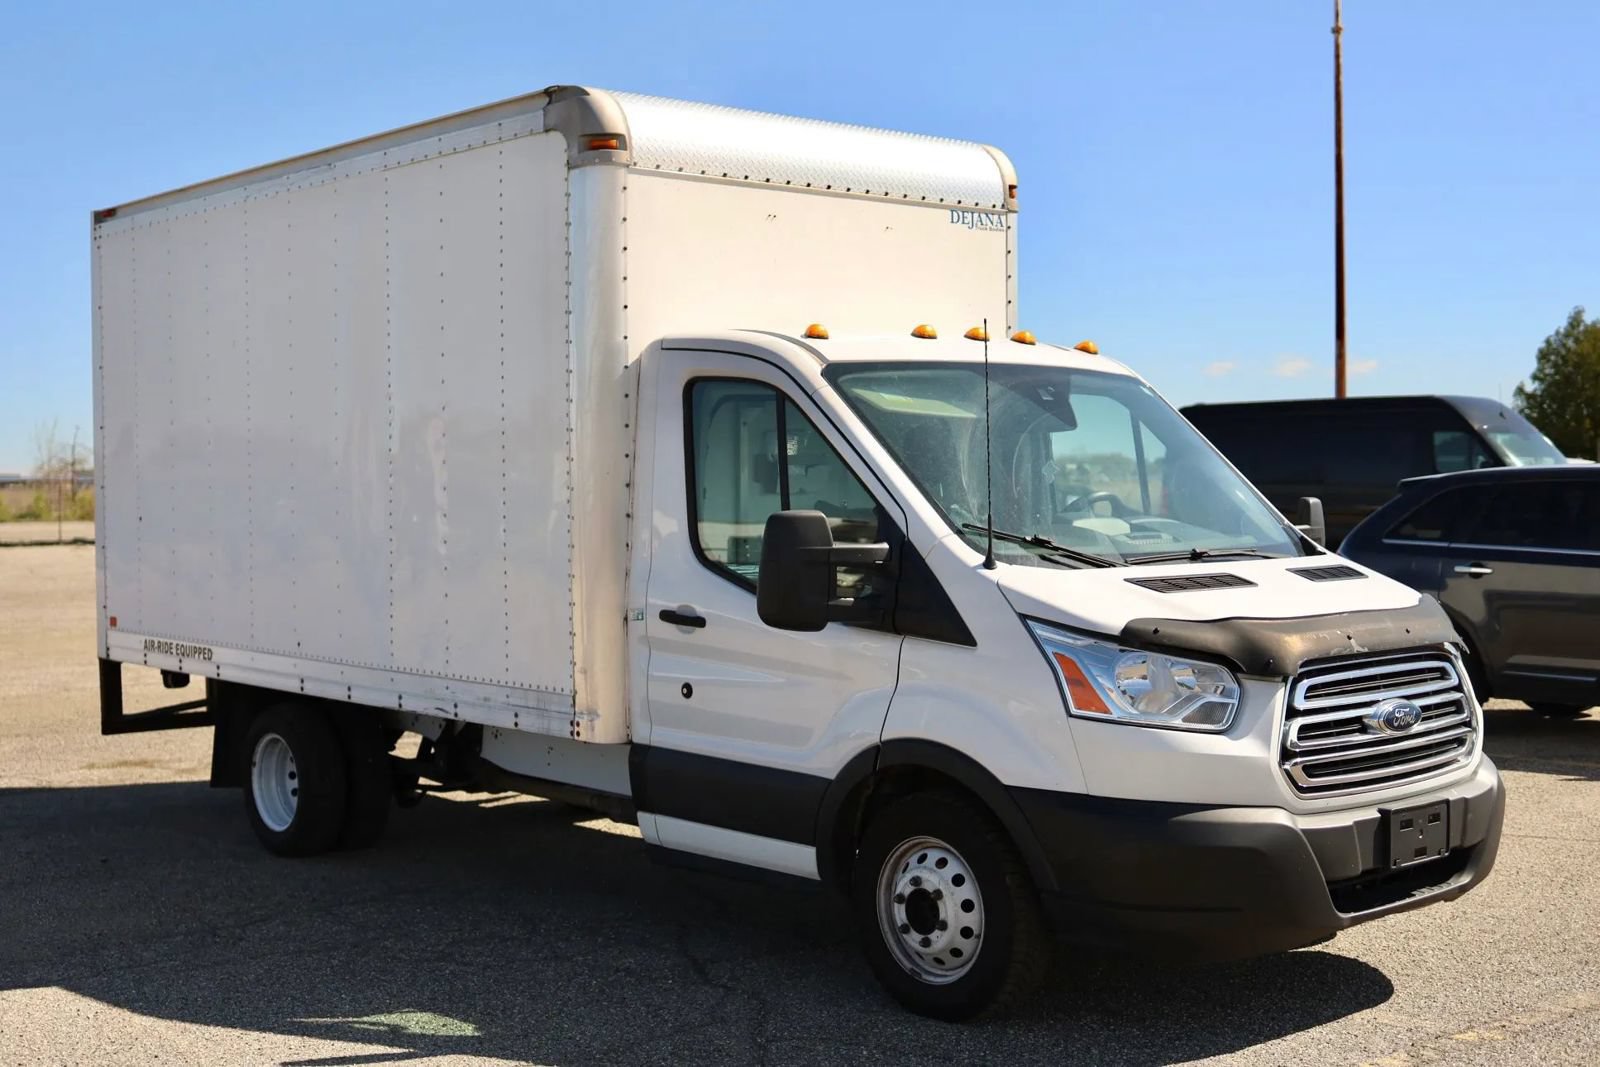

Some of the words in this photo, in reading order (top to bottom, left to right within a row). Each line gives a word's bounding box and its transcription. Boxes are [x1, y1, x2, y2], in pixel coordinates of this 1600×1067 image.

[950, 209, 1004, 229] DEJANA
[144, 638, 174, 655] AIR-RIDE
[175, 643, 213, 661] EQUIPPED
[1393, 708, 1416, 727] Ford
